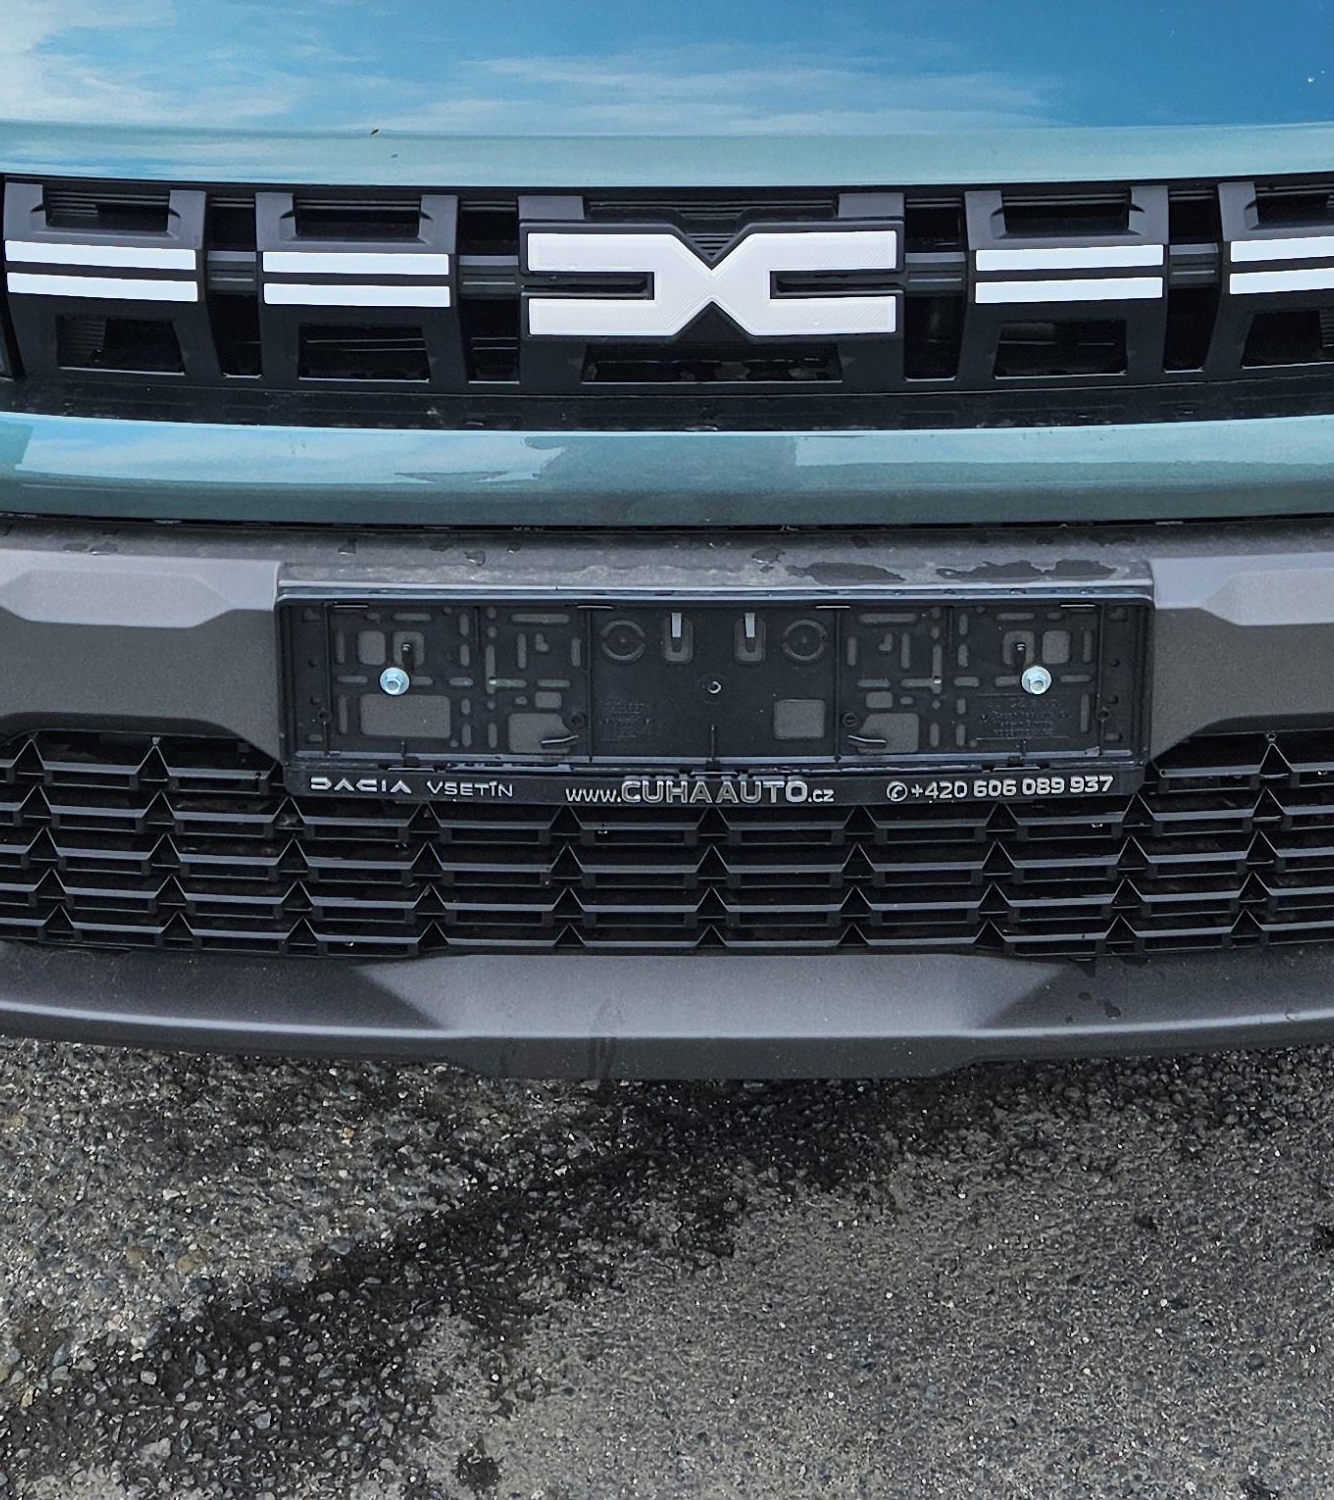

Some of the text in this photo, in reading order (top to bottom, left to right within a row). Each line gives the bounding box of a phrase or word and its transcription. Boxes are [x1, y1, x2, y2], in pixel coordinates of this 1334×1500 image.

[310, 775, 1114, 804] DACIA VSETÍN www.CUHAAUTO.cz +420 606 089 937
